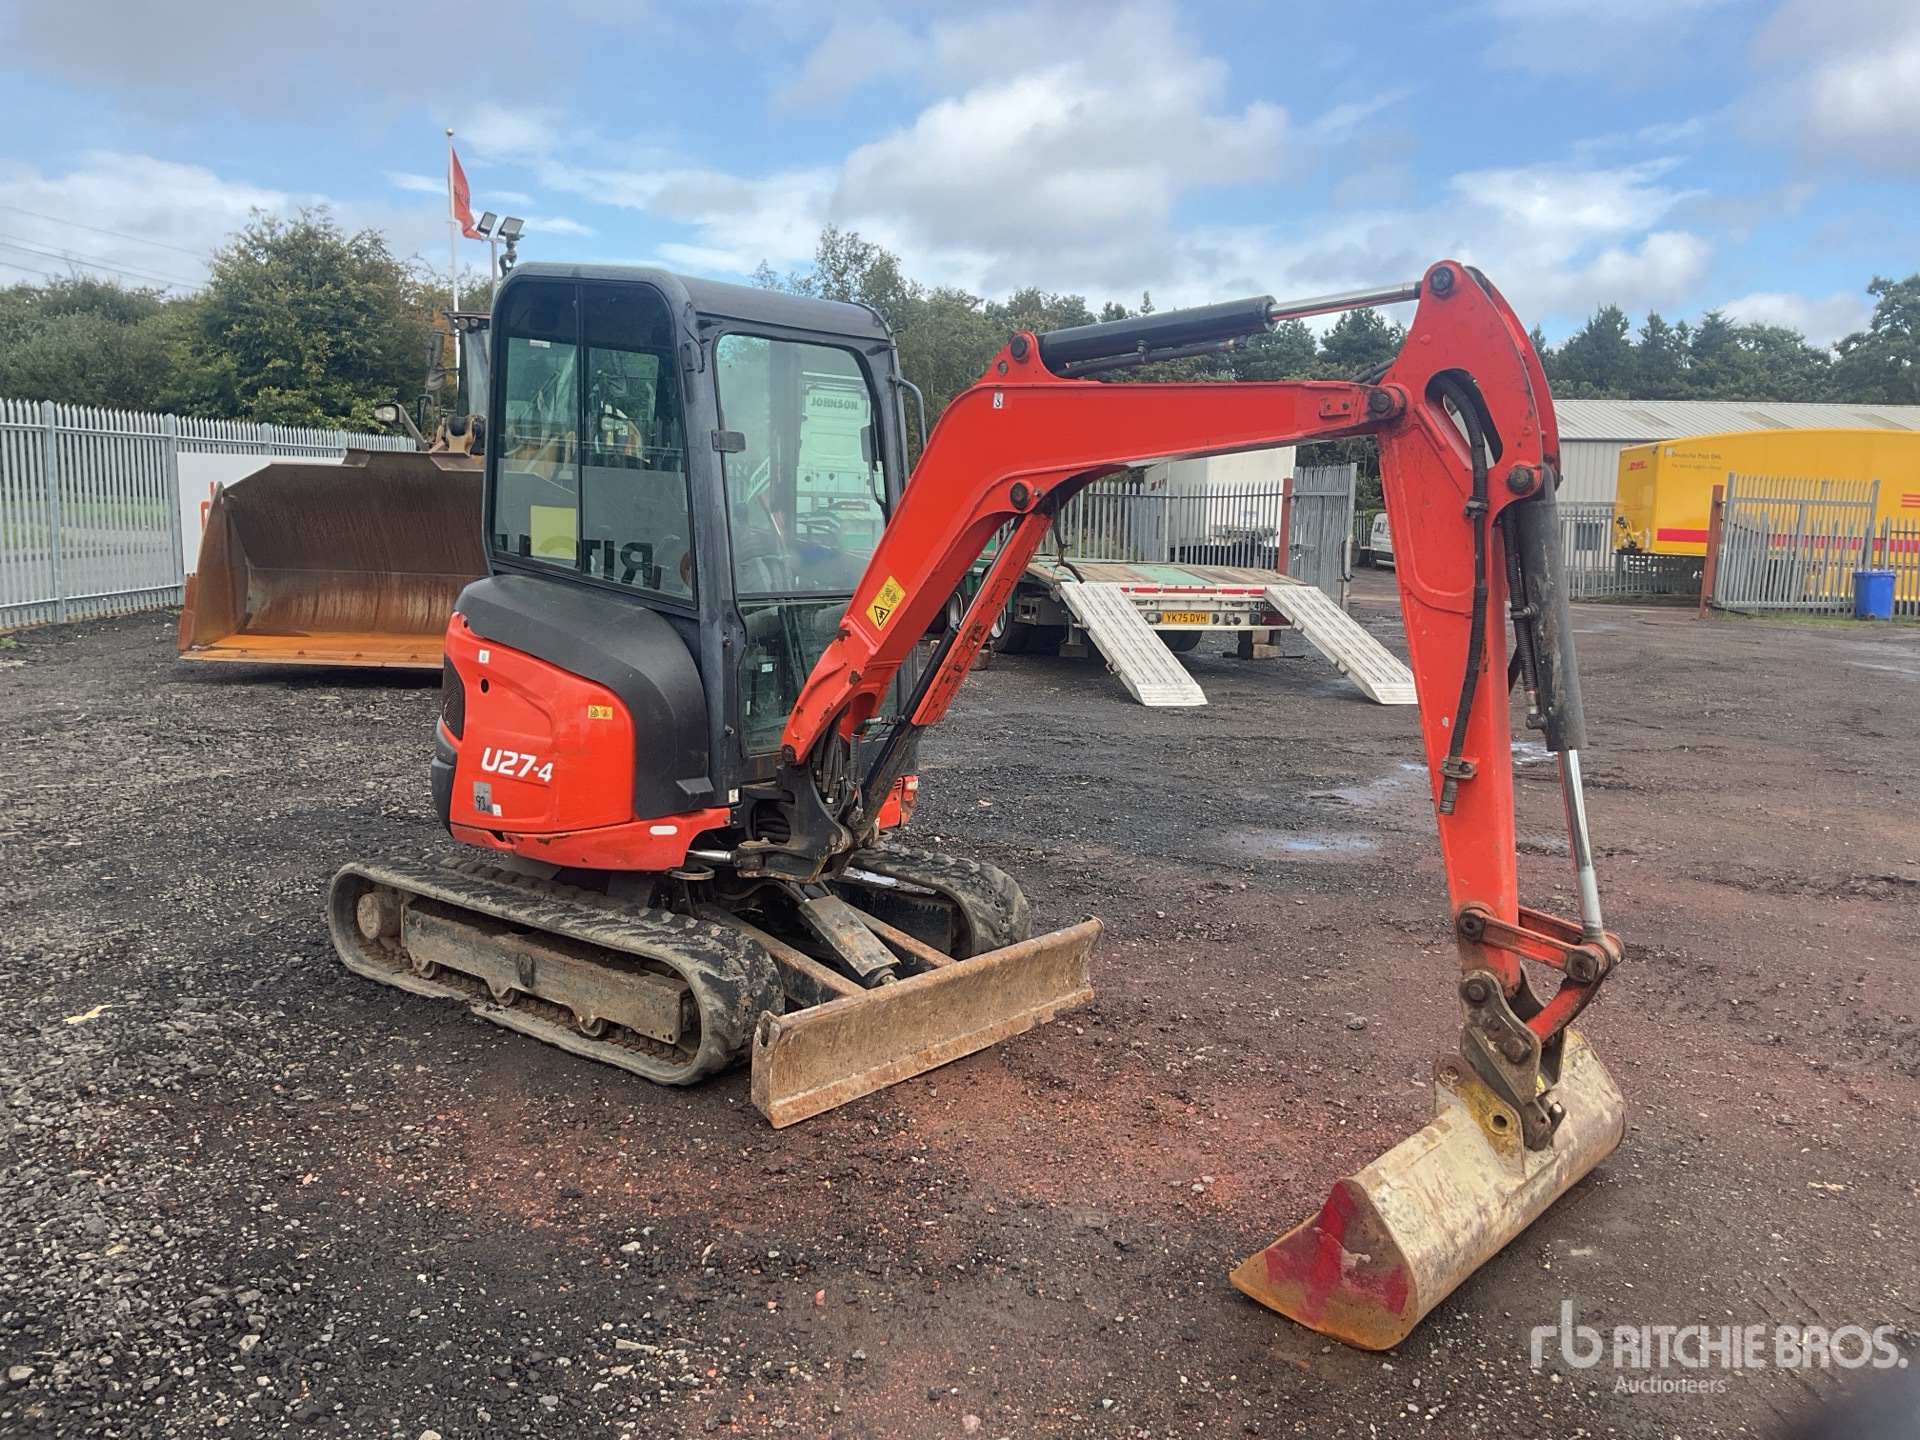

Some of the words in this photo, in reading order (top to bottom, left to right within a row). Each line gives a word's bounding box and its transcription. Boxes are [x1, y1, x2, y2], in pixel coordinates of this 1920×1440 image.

[811, 397, 858, 410] JOHNSON
[1166, 613, 1189, 623] YK75
[1189, 613, 1207, 623] DVH
[481, 747, 554, 782] U27-4
